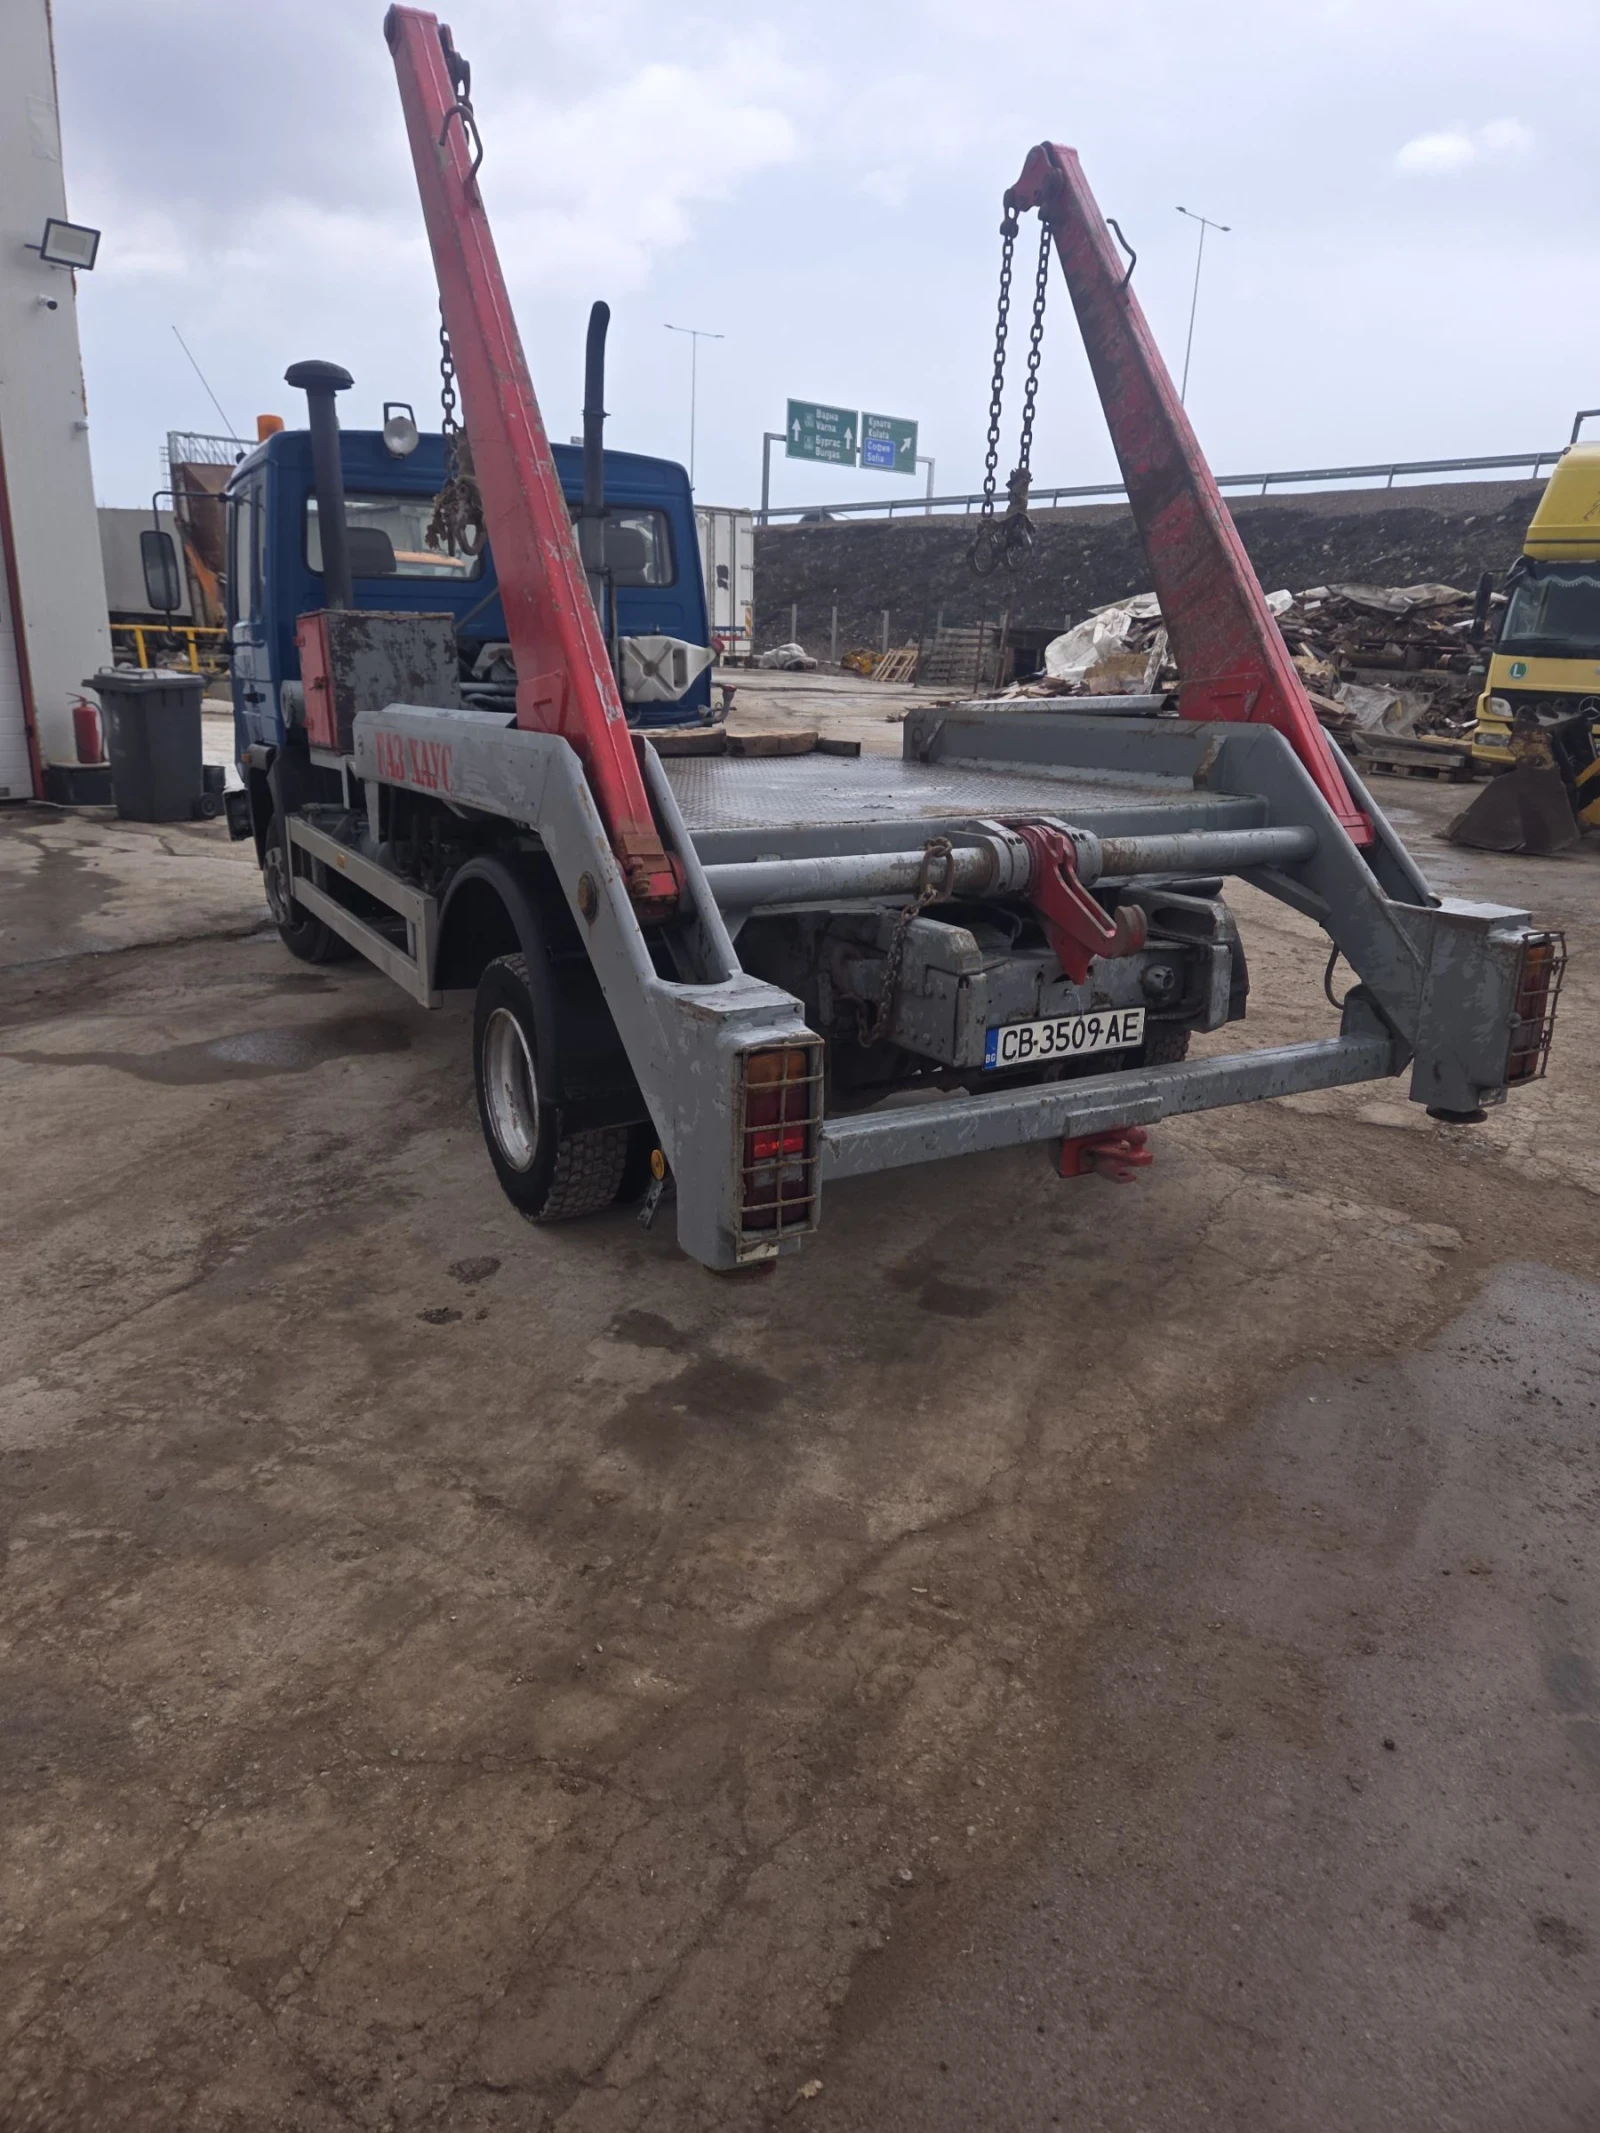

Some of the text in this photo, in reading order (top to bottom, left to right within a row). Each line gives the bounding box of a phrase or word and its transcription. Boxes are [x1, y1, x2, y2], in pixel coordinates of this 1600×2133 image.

[816, 408, 838, 422] Варна
[816, 420, 836, 433] Varna
[815, 446, 840, 460] Burgas
[867, 452, 884, 463] Sofia
[985, 1053, 996, 1064] BG
